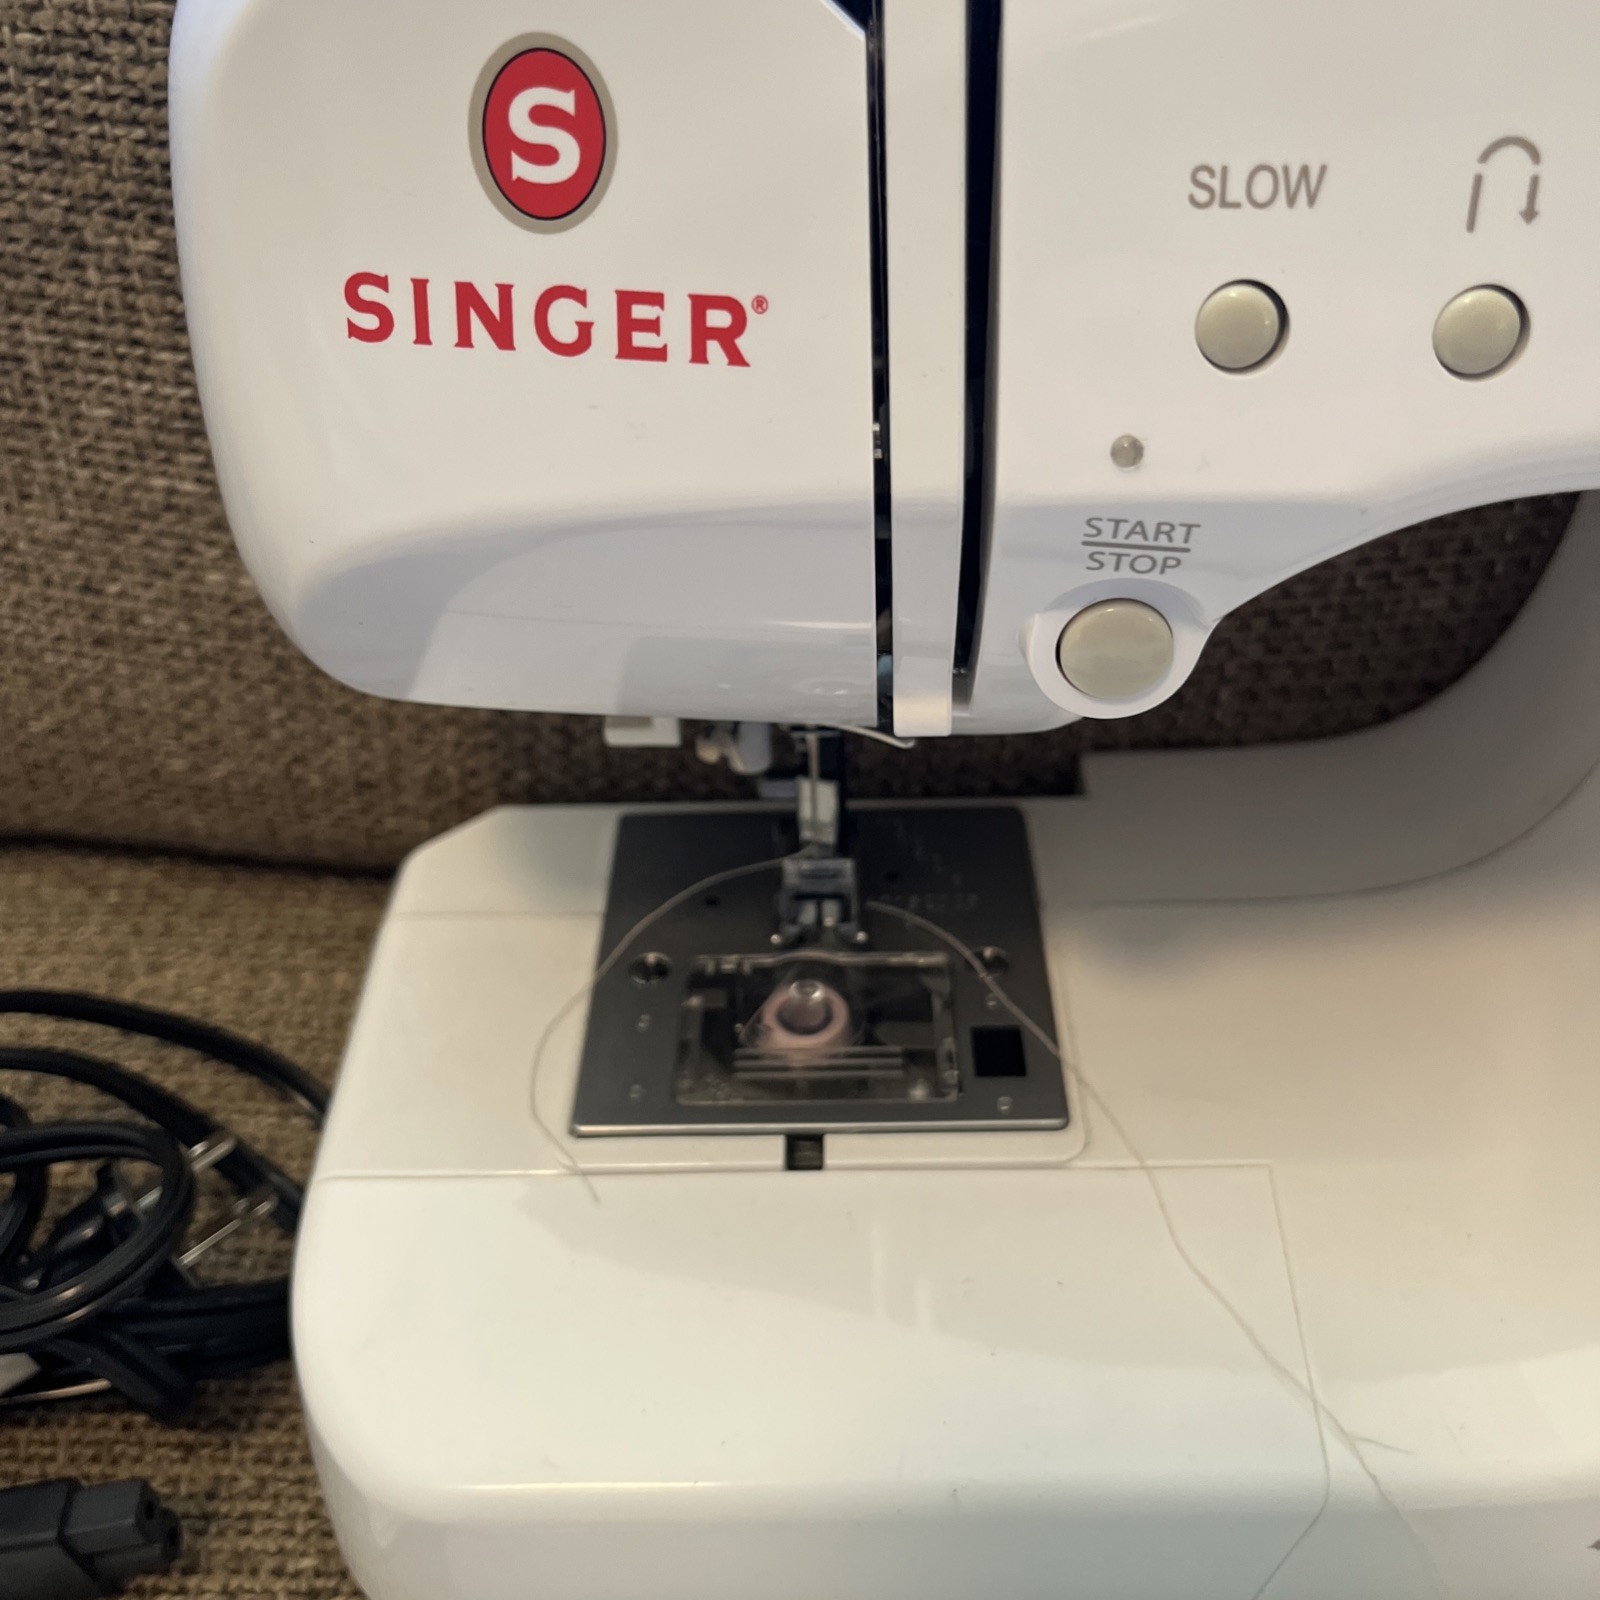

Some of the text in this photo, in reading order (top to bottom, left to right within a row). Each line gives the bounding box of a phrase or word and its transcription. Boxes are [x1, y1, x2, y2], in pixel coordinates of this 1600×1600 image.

[508, 86, 581, 185] S
[1188, 164, 1328, 210] SLOW
[1083, 517, 1202, 544] START
[1085, 551, 1182, 575] STOP
